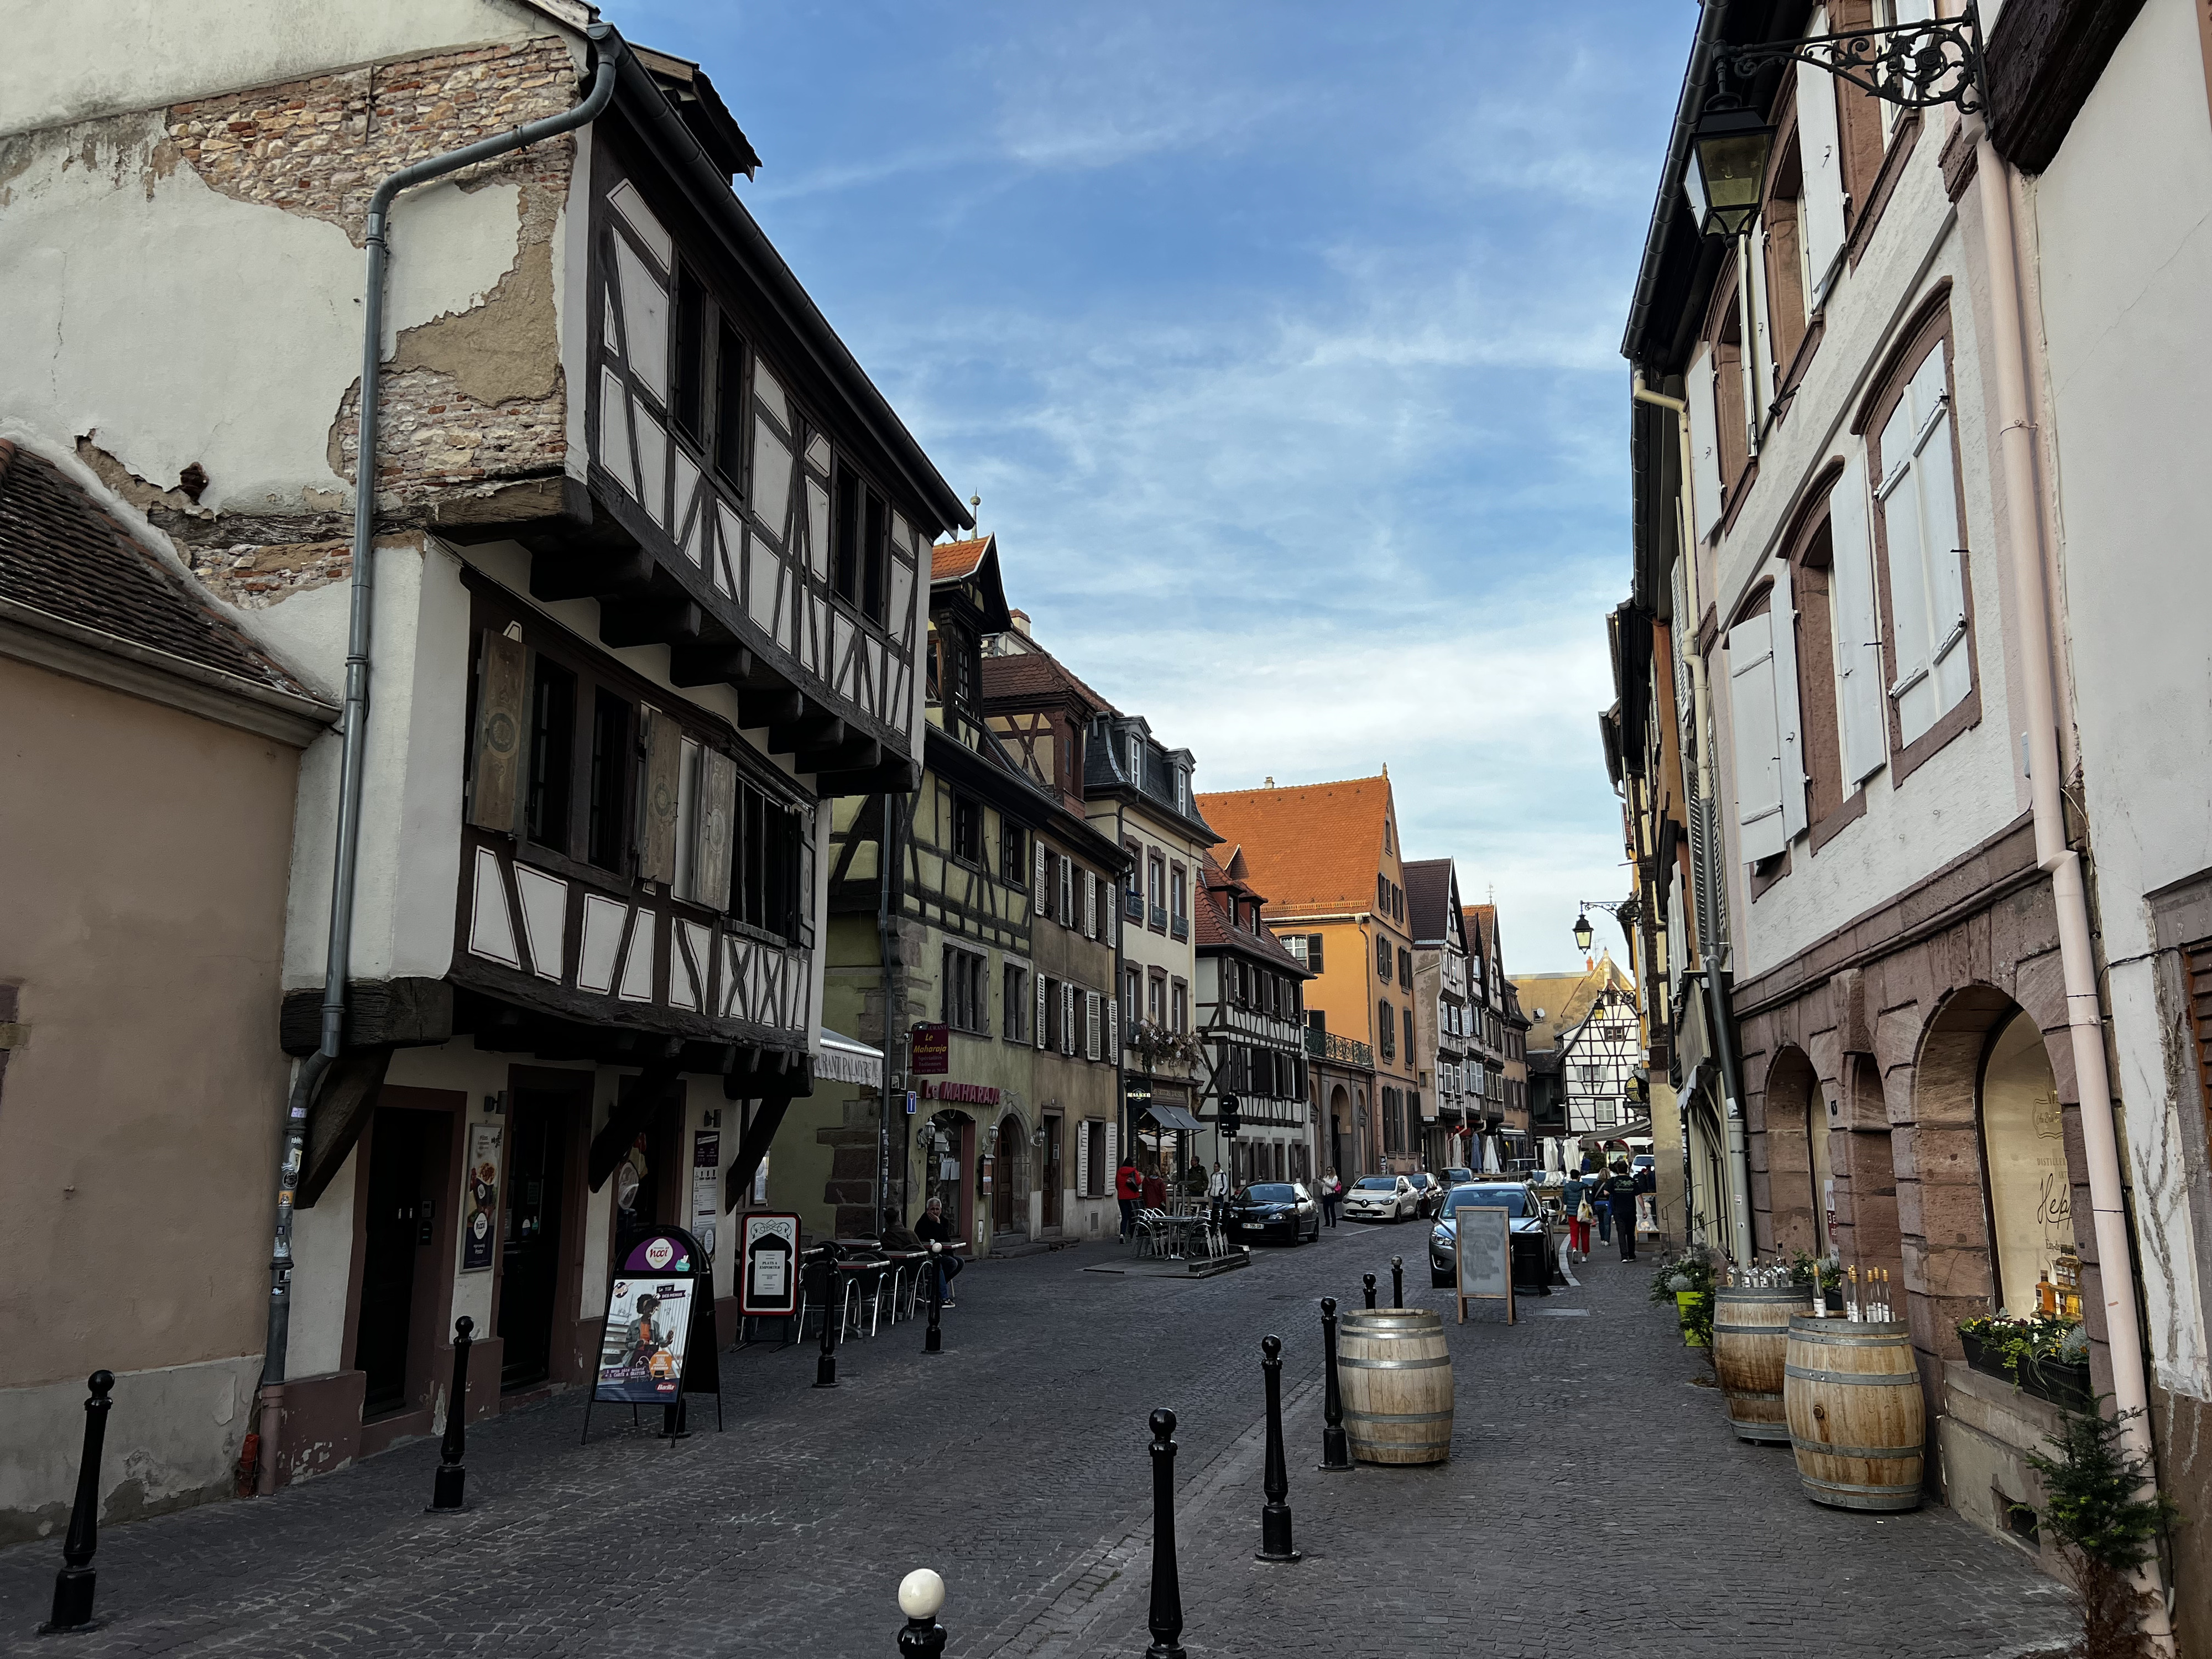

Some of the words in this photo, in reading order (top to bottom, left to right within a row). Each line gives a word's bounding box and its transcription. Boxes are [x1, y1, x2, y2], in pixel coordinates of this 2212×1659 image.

[913, 1044, 947, 1054] Maharaja
[921, 1079, 940, 1099] Le
[940, 1082, 1000, 1105] MAHARAJA
